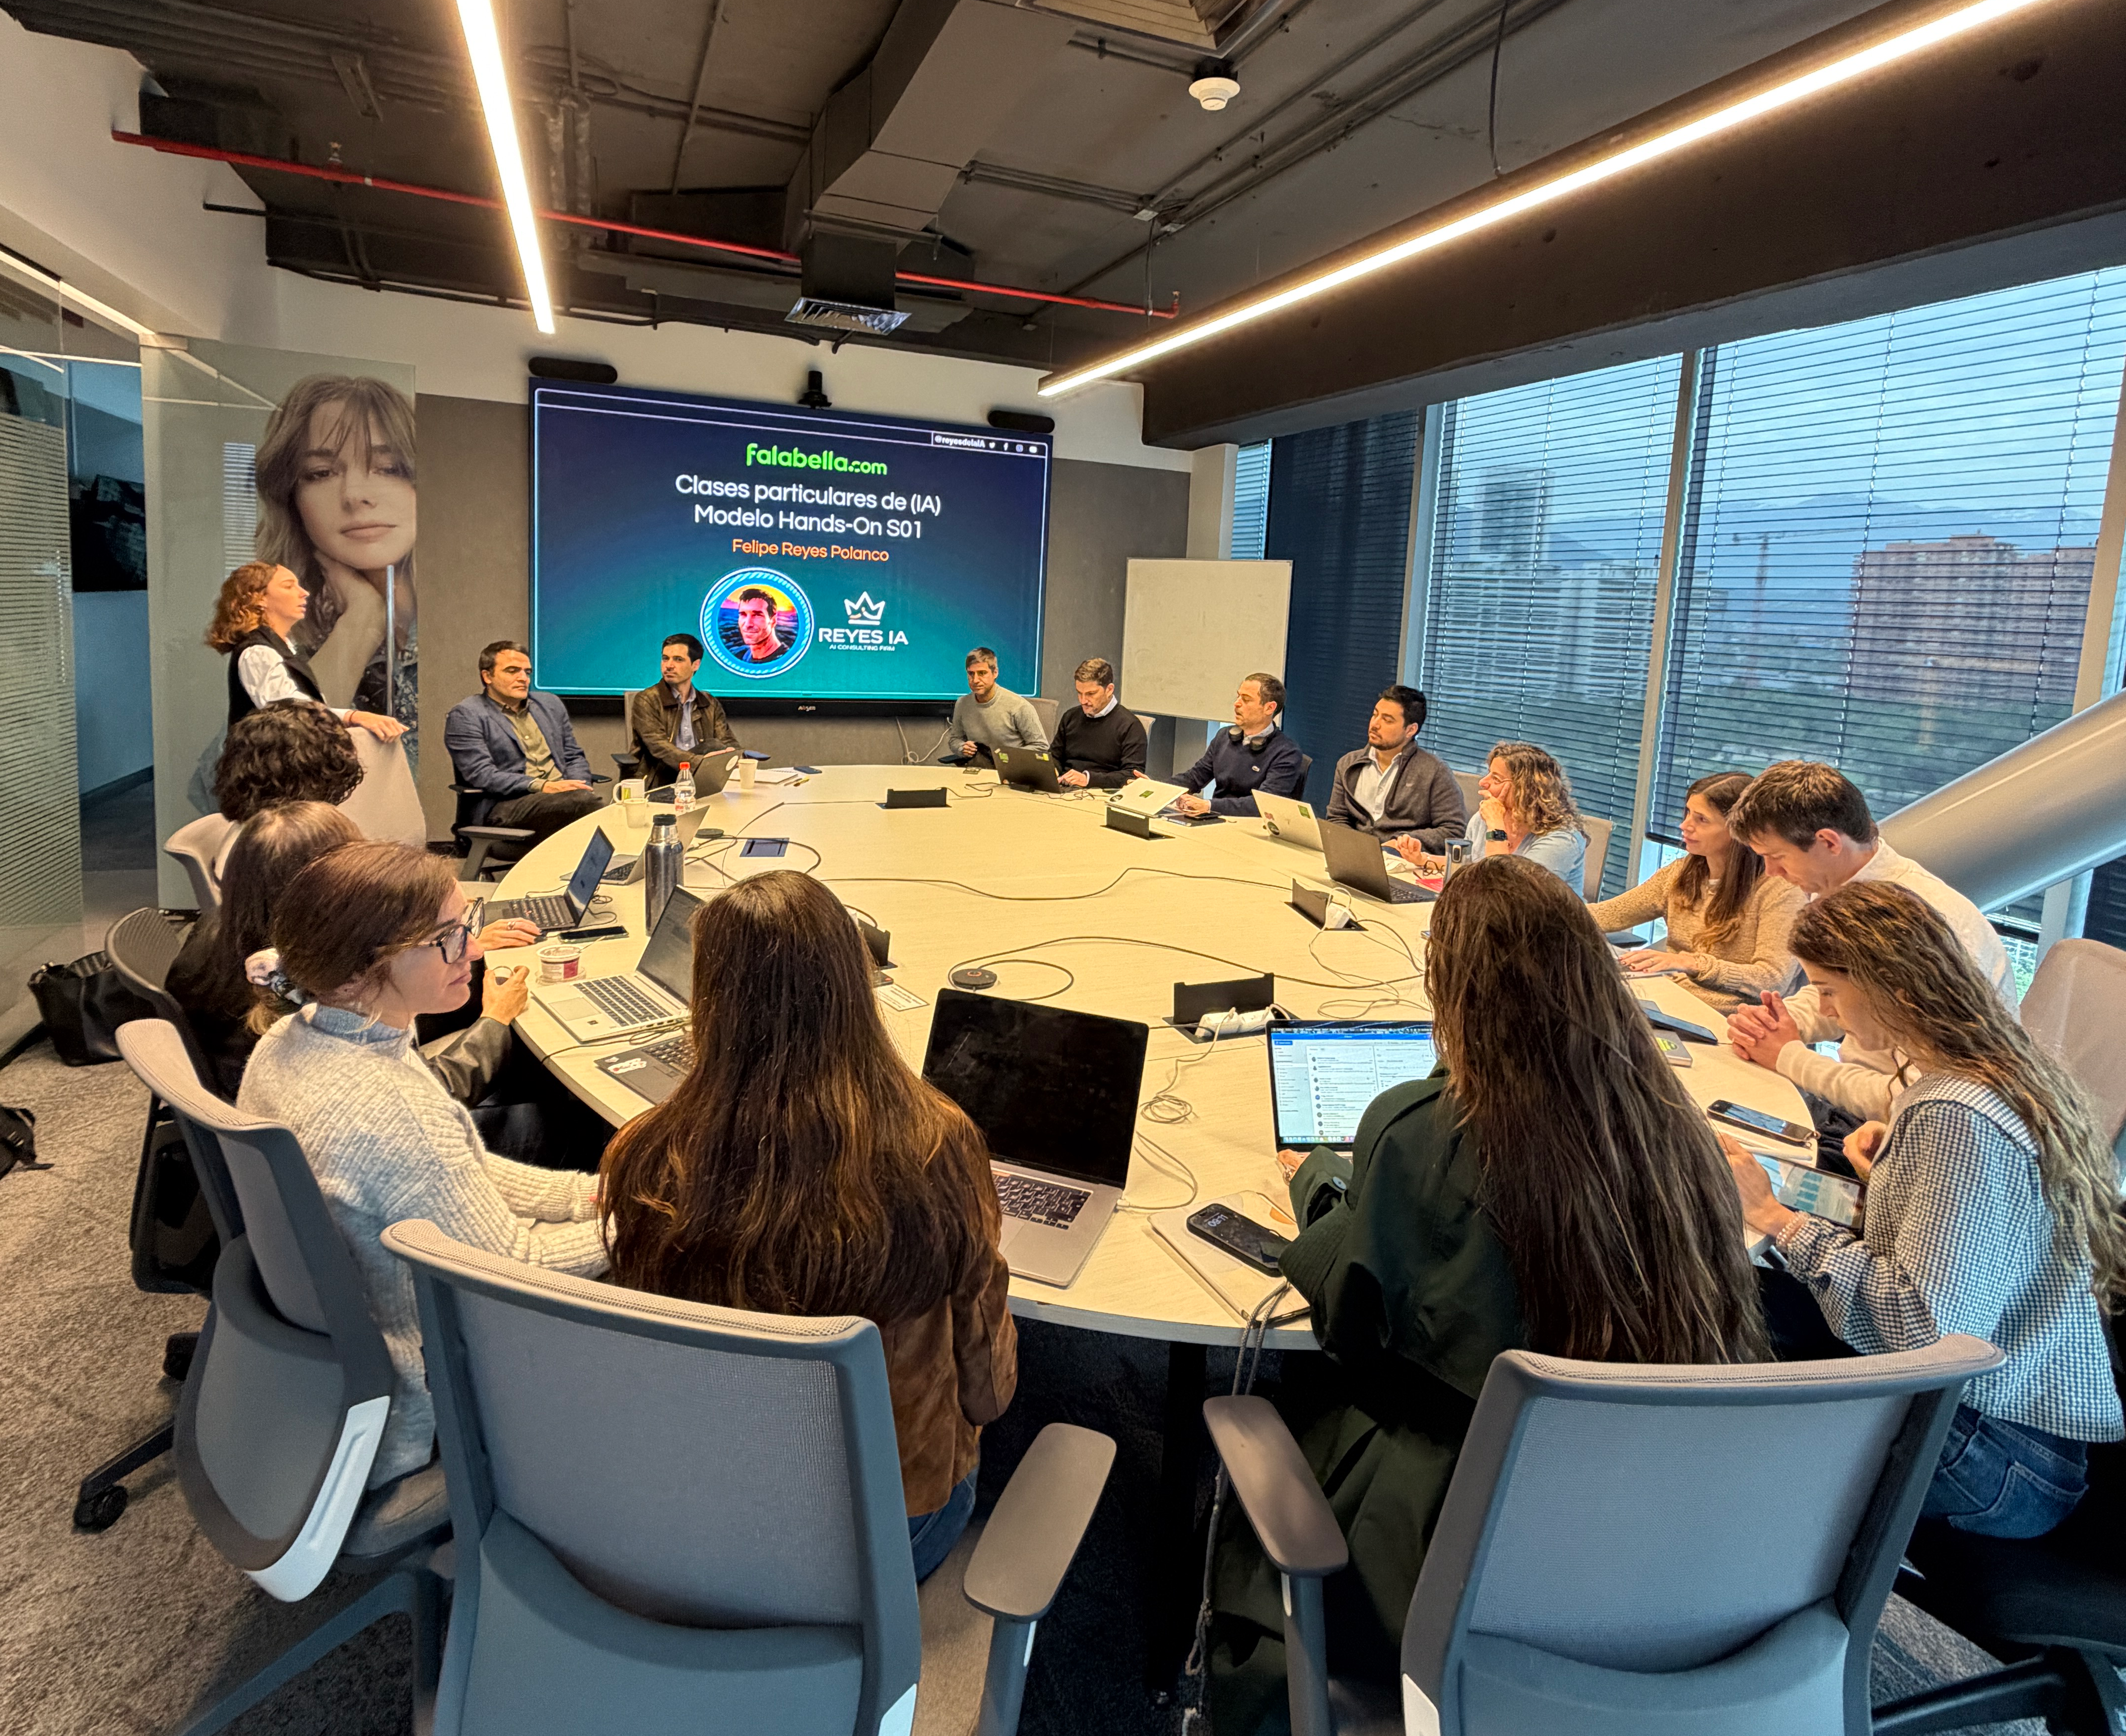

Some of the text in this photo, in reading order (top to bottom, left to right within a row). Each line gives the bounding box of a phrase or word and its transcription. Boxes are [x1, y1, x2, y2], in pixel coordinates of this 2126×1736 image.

[746, 443, 887, 475] falabella.com
[675, 474, 941, 517] Clases particulares de (IA)
[694, 504, 921, 538] Modelo Hands-On S01
[732, 538, 889, 562] Felipe Reyes Polanco
[819, 627, 909, 645] REYES IA
